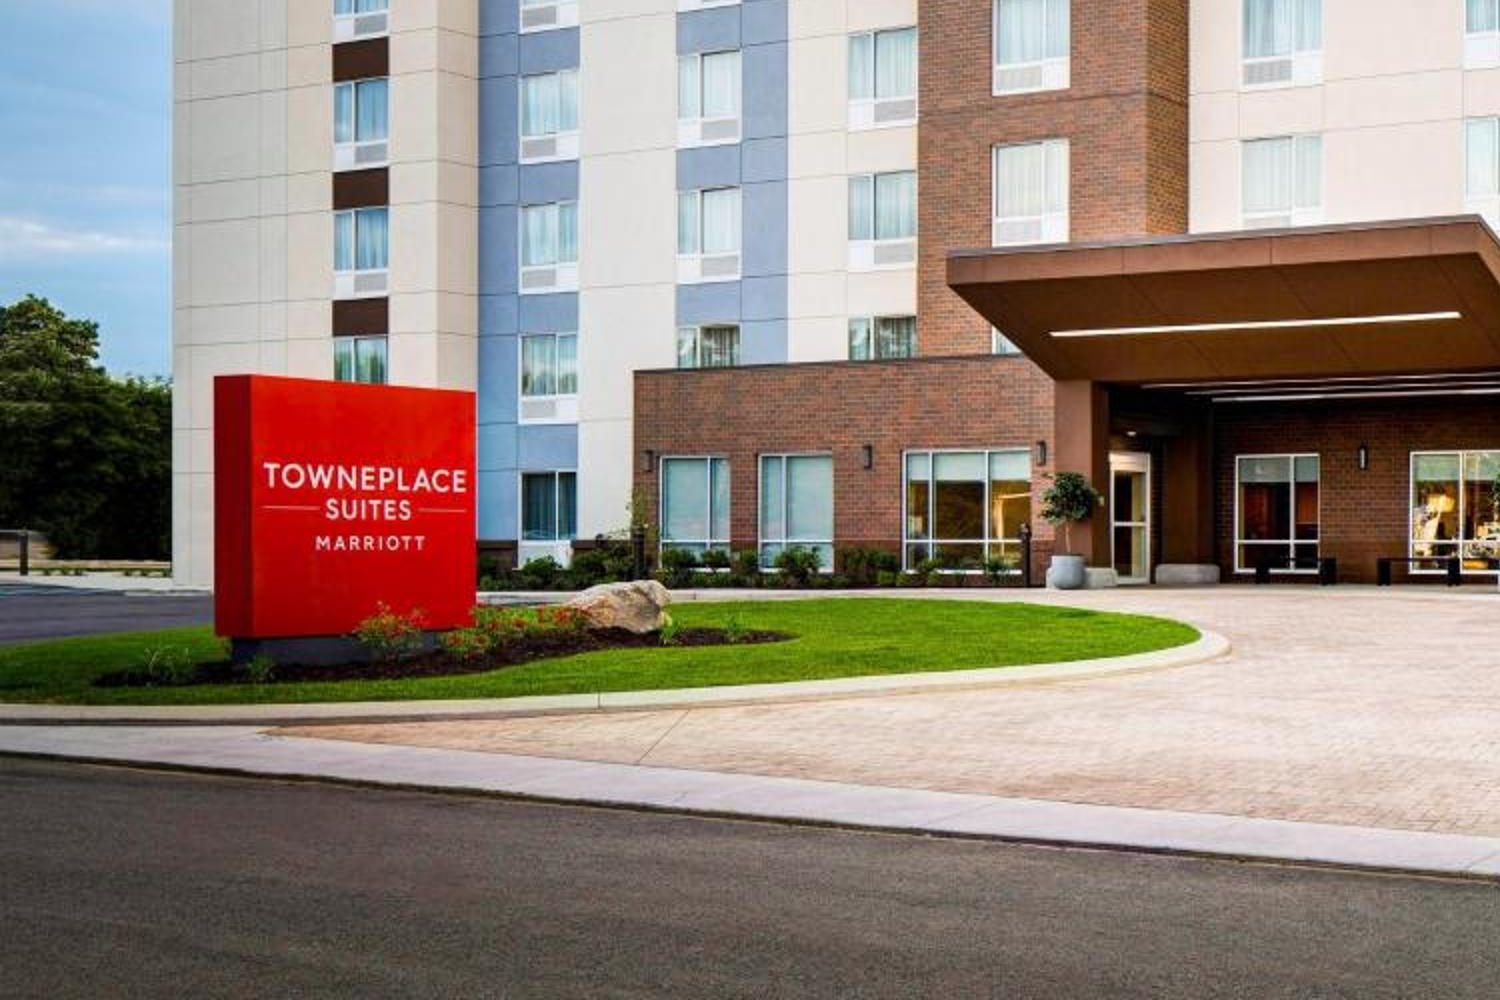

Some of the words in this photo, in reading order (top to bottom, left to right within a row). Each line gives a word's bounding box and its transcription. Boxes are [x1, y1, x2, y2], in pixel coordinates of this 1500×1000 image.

[263, 462, 467, 493] TOWNEPLACE
[325, 498, 411, 521] SUITES
[315, 535, 425, 551] MARRIOTT
